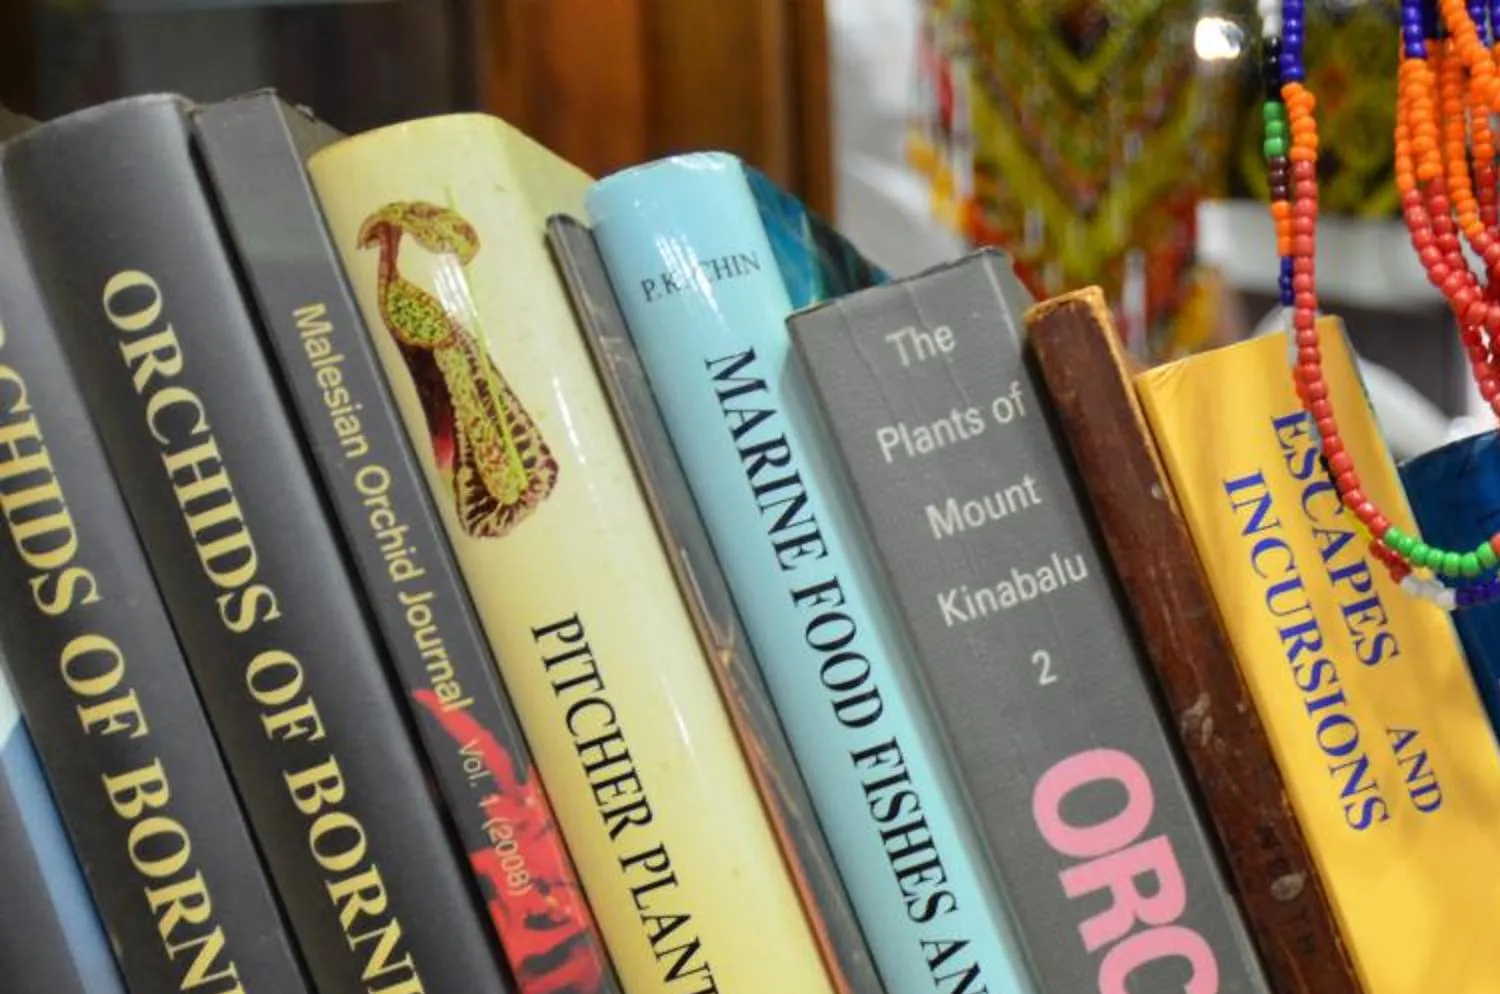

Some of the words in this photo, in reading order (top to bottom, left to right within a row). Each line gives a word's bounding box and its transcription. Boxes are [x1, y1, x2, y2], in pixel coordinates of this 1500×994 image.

[875, 402, 985, 463] Plants
[992, 383, 1028, 425] of
[885, 322, 956, 369] The
[102, 270, 282, 632] ORCHIDS
[245, 649, 326, 743] OF
[926, 475, 1041, 541] Mount
[936, 551, 1088, 628] Kinabalu
[292, 303, 368, 460] Malesian
[354, 463, 425, 583] Orchid
[398, 581, 477, 714] Journal
[457, 738, 492, 788] Vol.
[481, 817, 533, 897] (2008)
[705, 347, 827, 573] MARINE
[791, 577, 885, 730] FOOD
[850, 739, 960, 924] FISHES
[1031, 651, 1058, 687] 2
[1223, 469, 1388, 831] INCURSIONS
[1269, 411, 1400, 669] ESCAPES
[1386, 727, 1443, 814] AND
[60, 633, 149, 740] OF
[530, 612, 654, 843] PITCHER
